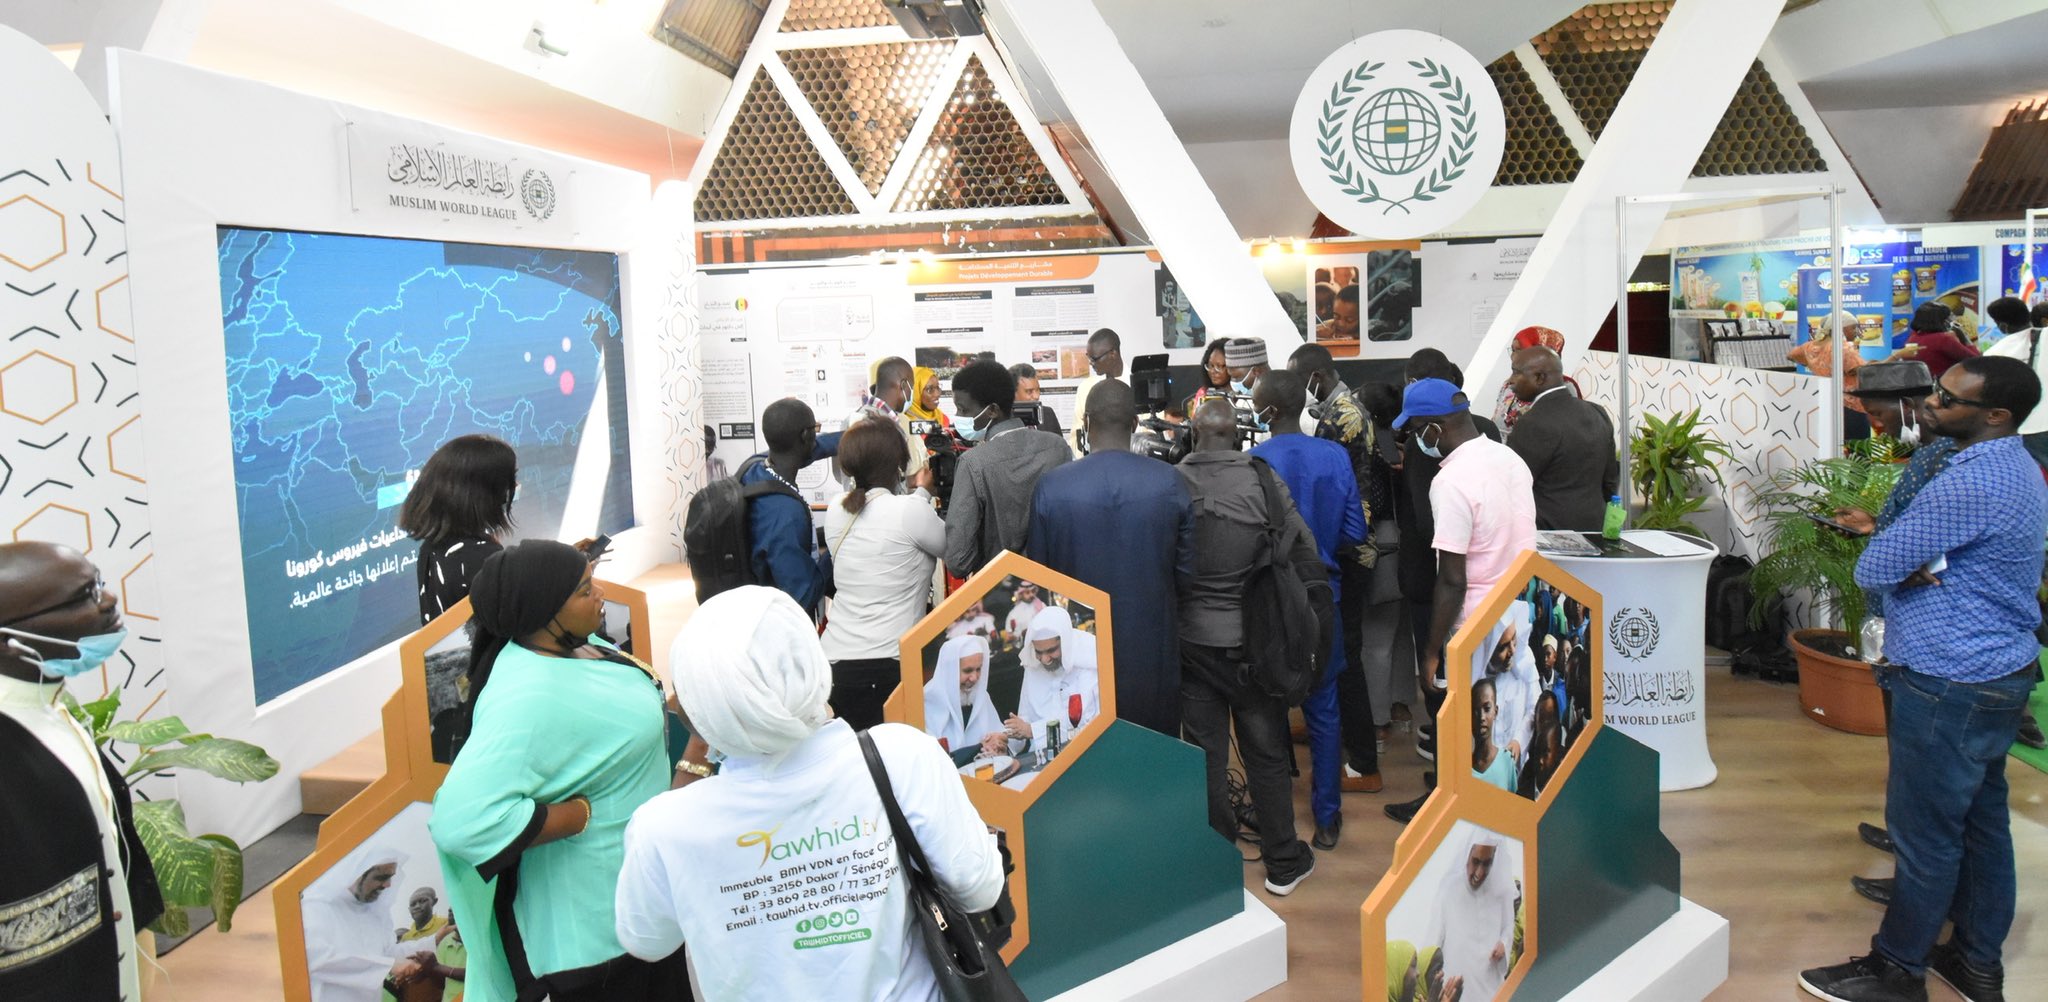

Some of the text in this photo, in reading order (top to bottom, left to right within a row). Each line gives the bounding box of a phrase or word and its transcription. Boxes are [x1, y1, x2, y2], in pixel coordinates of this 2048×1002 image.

[443, 152, 481, 190] العالم
[480, 163, 514, 199] رابطة
[389, 194, 518, 220] MUSLIM WORLD LEAGUE
[1995, 228, 2026, 238] COMPAGN
[1861, 248, 1883, 259] CSS
[958, 272, 979, 280] Projets
[1029, 269, 1053, 277] Durable
[1841, 272, 1870, 284] CSS
[285, 525, 409, 578] داعيات فيروس كورونا
[365, 554, 399, 582] إعلانها
[334, 569, 364, 592] جائحة
[1622, 671, 1663, 706] العالم
[1661, 668, 1695, 706] رابطة
[1618, 715, 1659, 725] WORLD
[1662, 711, 1696, 725] LEAGUE
[720, 874, 774, 894] Immeuble
[780, 863, 807, 880] BMH
[809, 857, 833, 871] VDN
[836, 854, 850, 865] en
[852, 849, 875, 860] face
[743, 889, 760, 901] BP
[769, 879, 803, 895] 32156
[806, 871, 839, 885] Dakar
[843, 866, 848, 876] /
[725, 916, 757, 932] Email
[765, 886, 889, 922] tawhid.tv.officiel@gma
[731, 904, 750, 916] Tél
[759, 899, 774, 910] 33
[777, 893, 800, 906] 869
[802, 888, 818, 898] 28
[820, 883, 836, 893] 80
[839, 880, 844, 890] /
[847, 878, 859, 889] 77
[862, 873, 881, 885] 327
